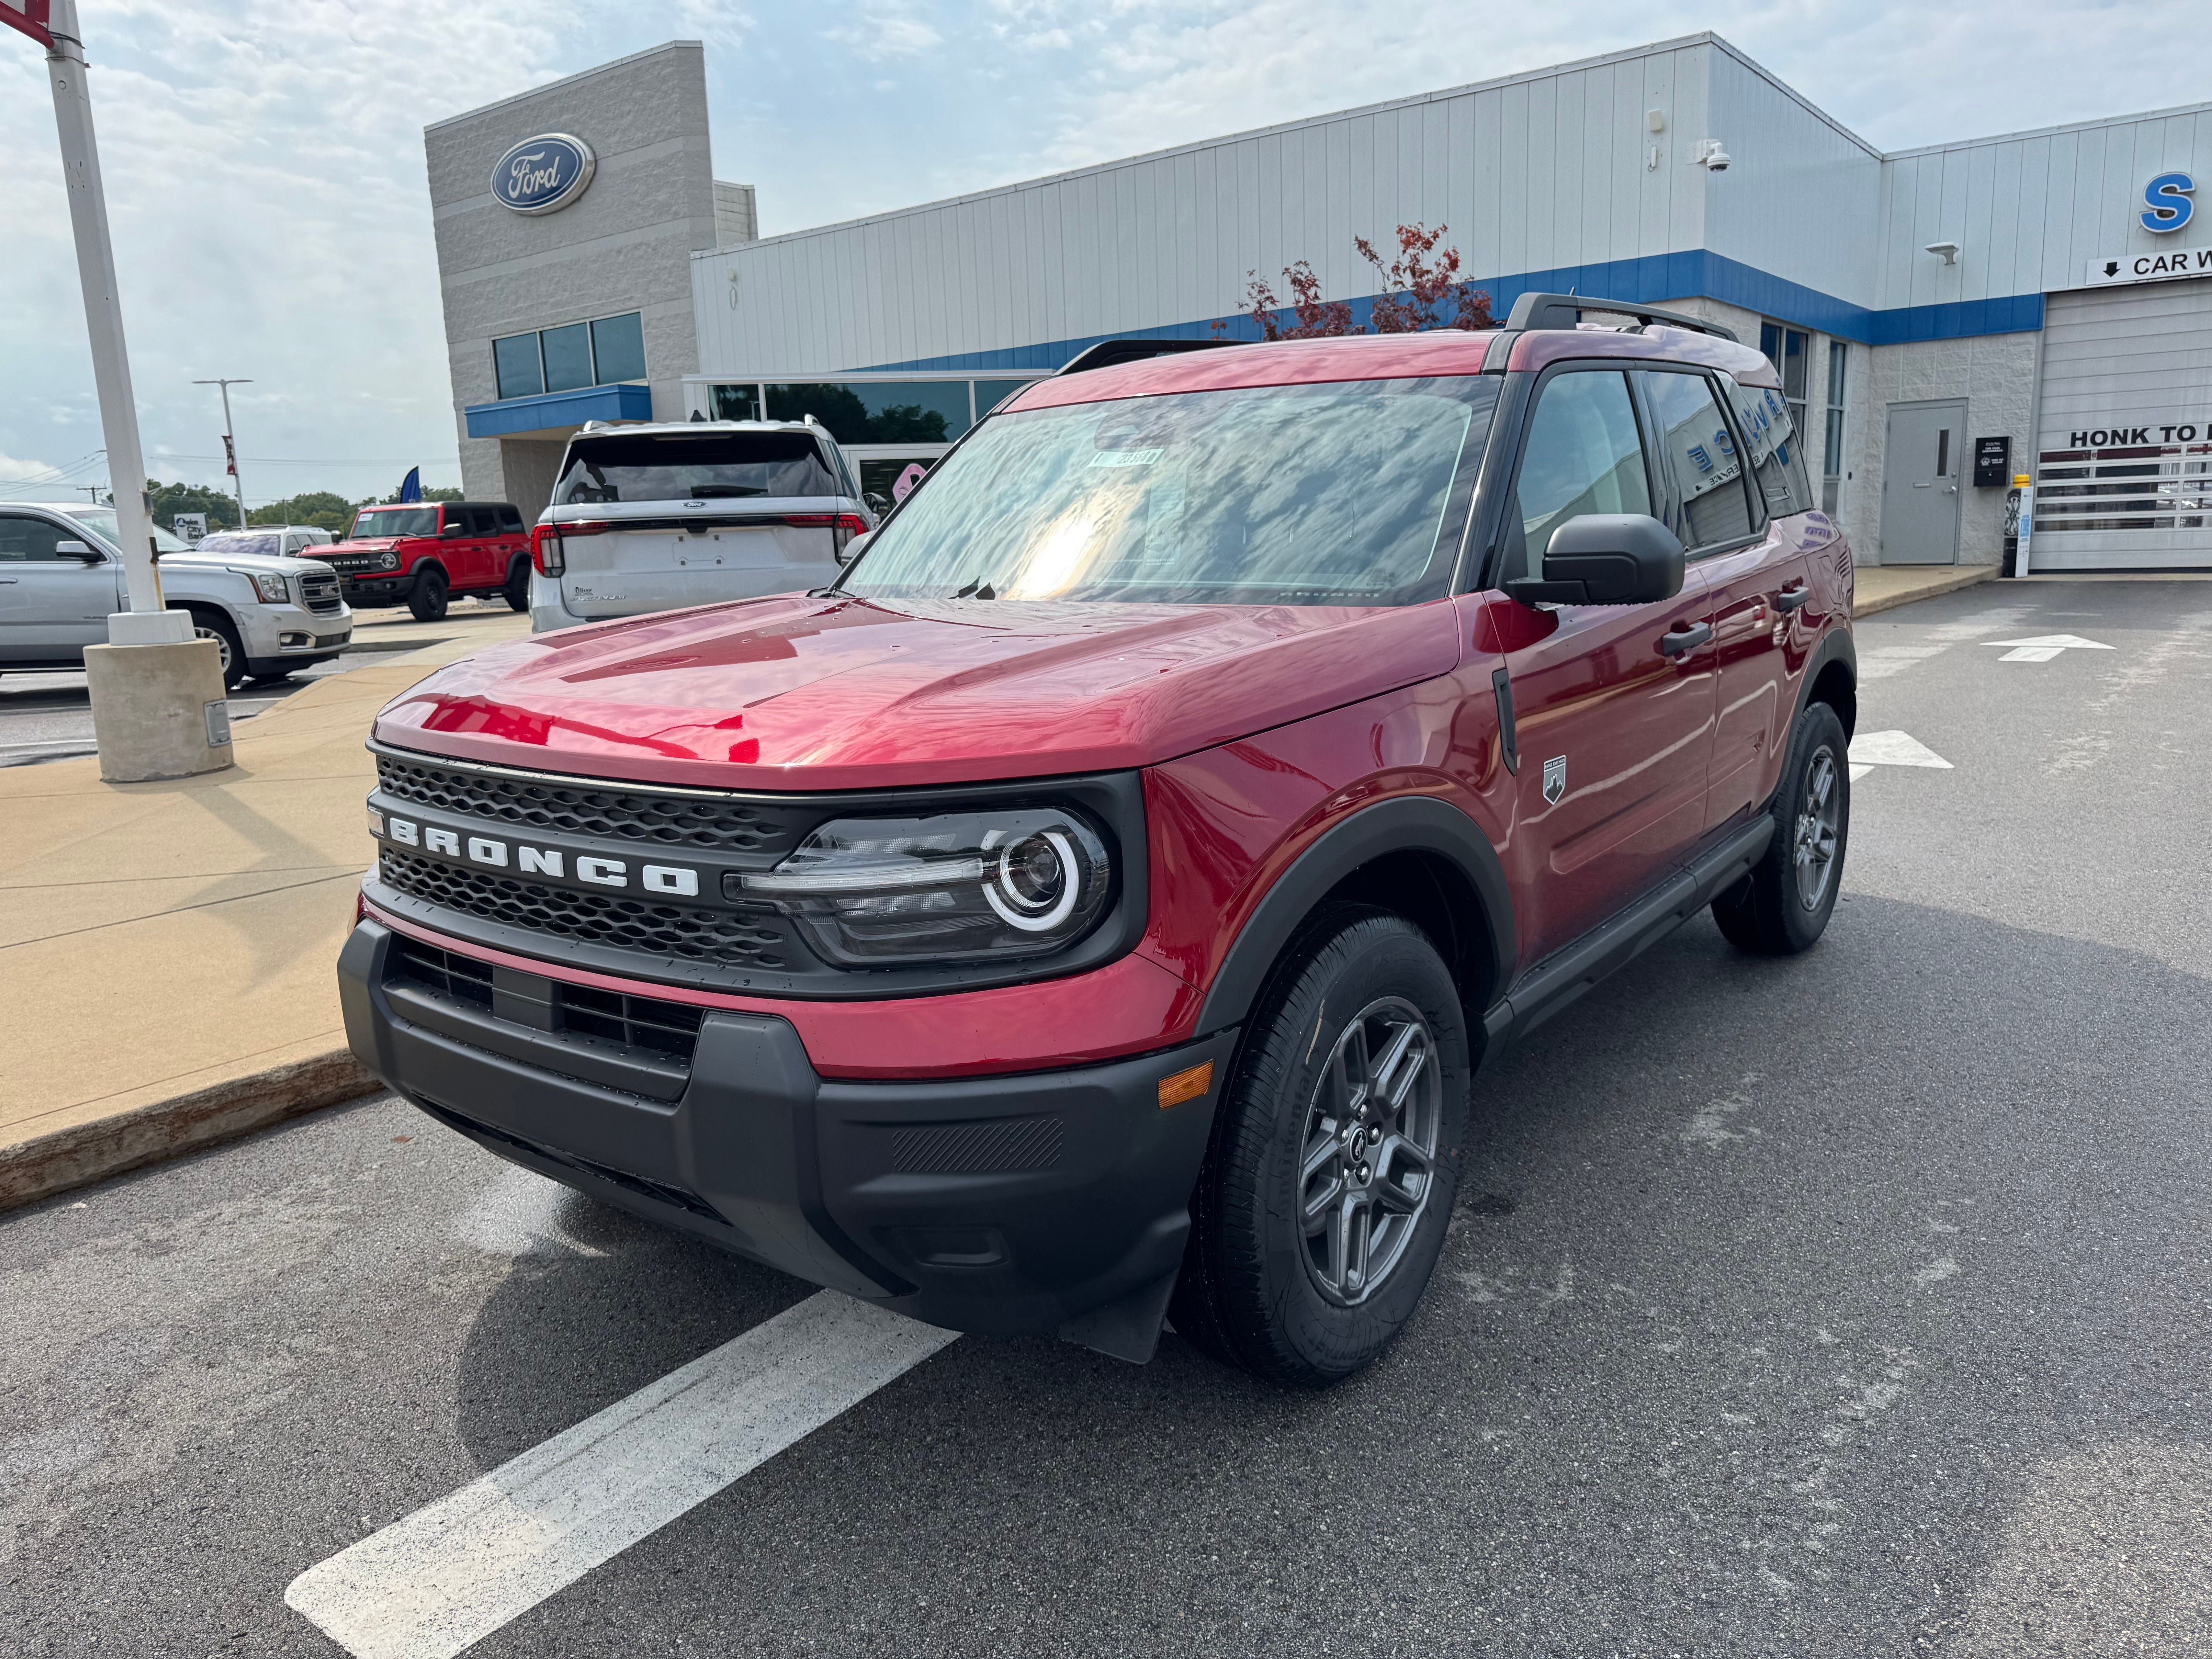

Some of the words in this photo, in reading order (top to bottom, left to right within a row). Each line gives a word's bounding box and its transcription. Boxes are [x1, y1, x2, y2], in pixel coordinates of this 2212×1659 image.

[508, 151, 560, 199] Ford
[2139, 171, 2195, 233] S
[2134, 254, 2188, 275] CAR
[2070, 427, 2150, 448] HONK
[2159, 425, 2196, 442] TO
[1116, 451, 1151, 464] 23568
[389, 817, 699, 897] BRONCO
